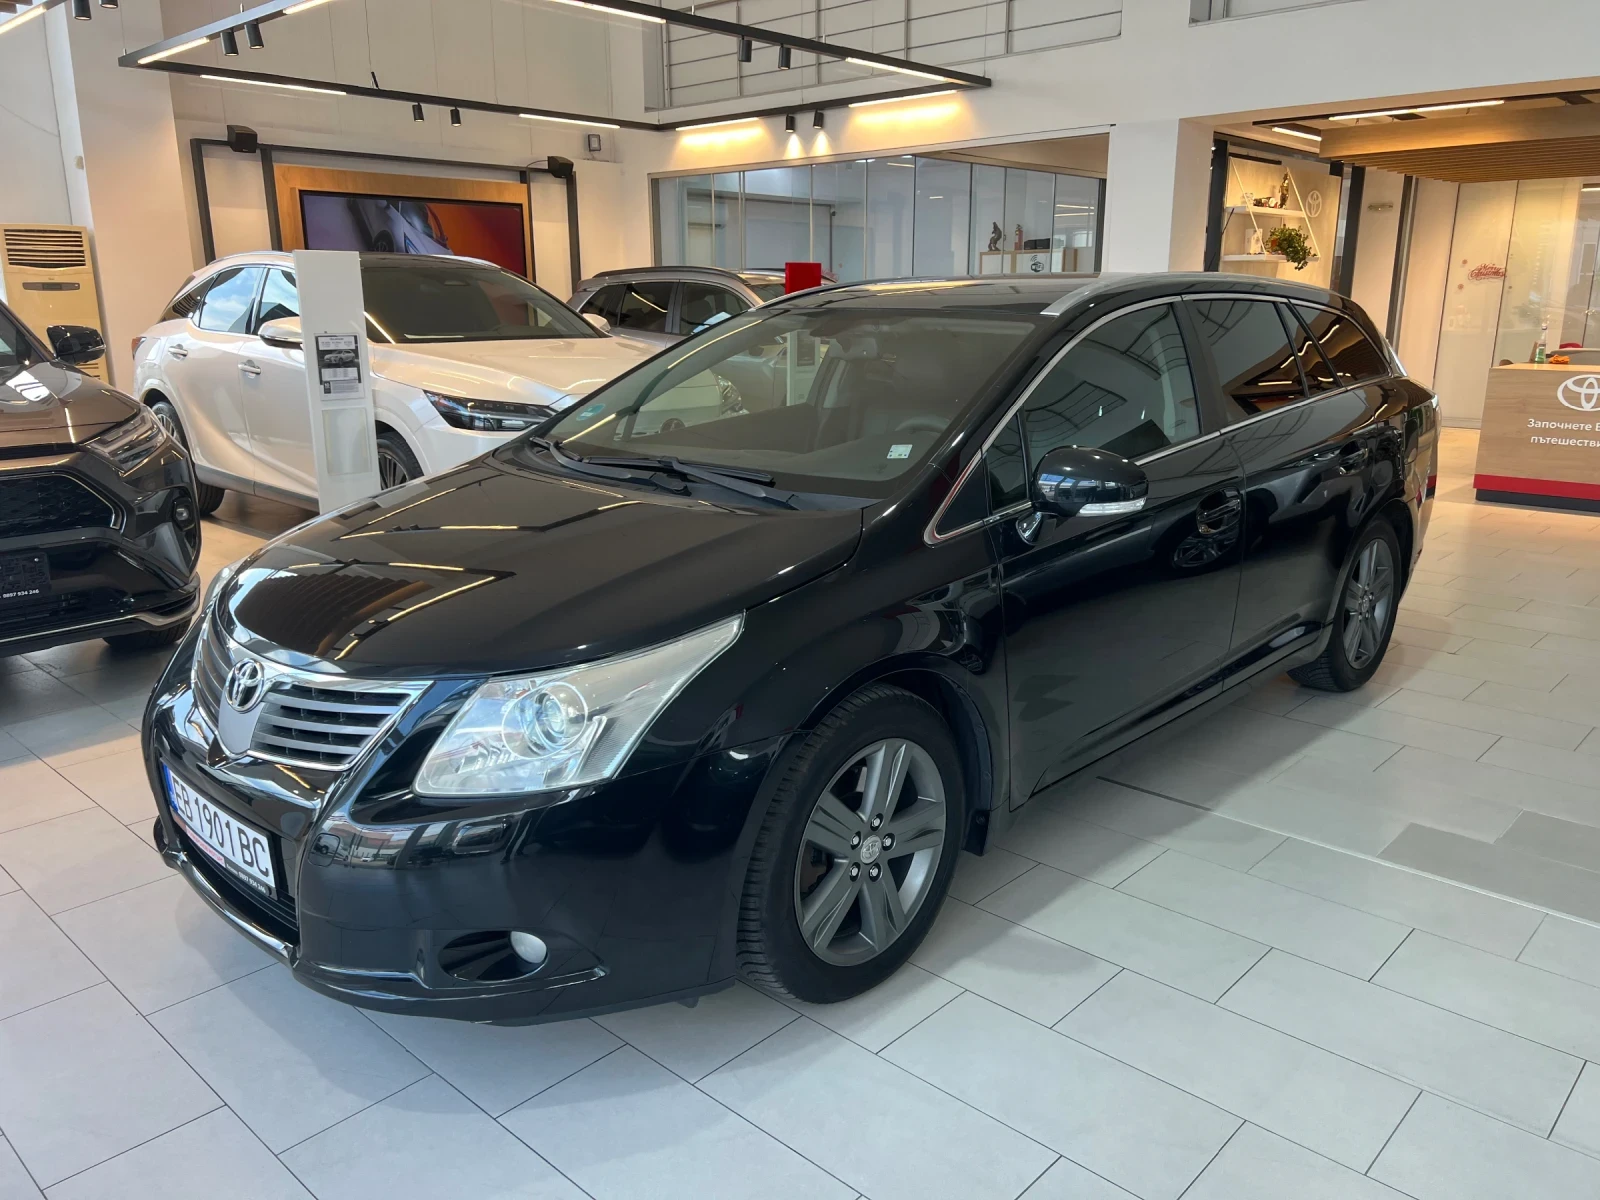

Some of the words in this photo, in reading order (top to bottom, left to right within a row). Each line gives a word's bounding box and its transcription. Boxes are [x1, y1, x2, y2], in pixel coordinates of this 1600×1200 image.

[1527, 418, 1592, 431] Започнете
[172, 776, 193, 822] EB
[195, 797, 236, 858] 1901
[237, 826, 270, 878] BC
